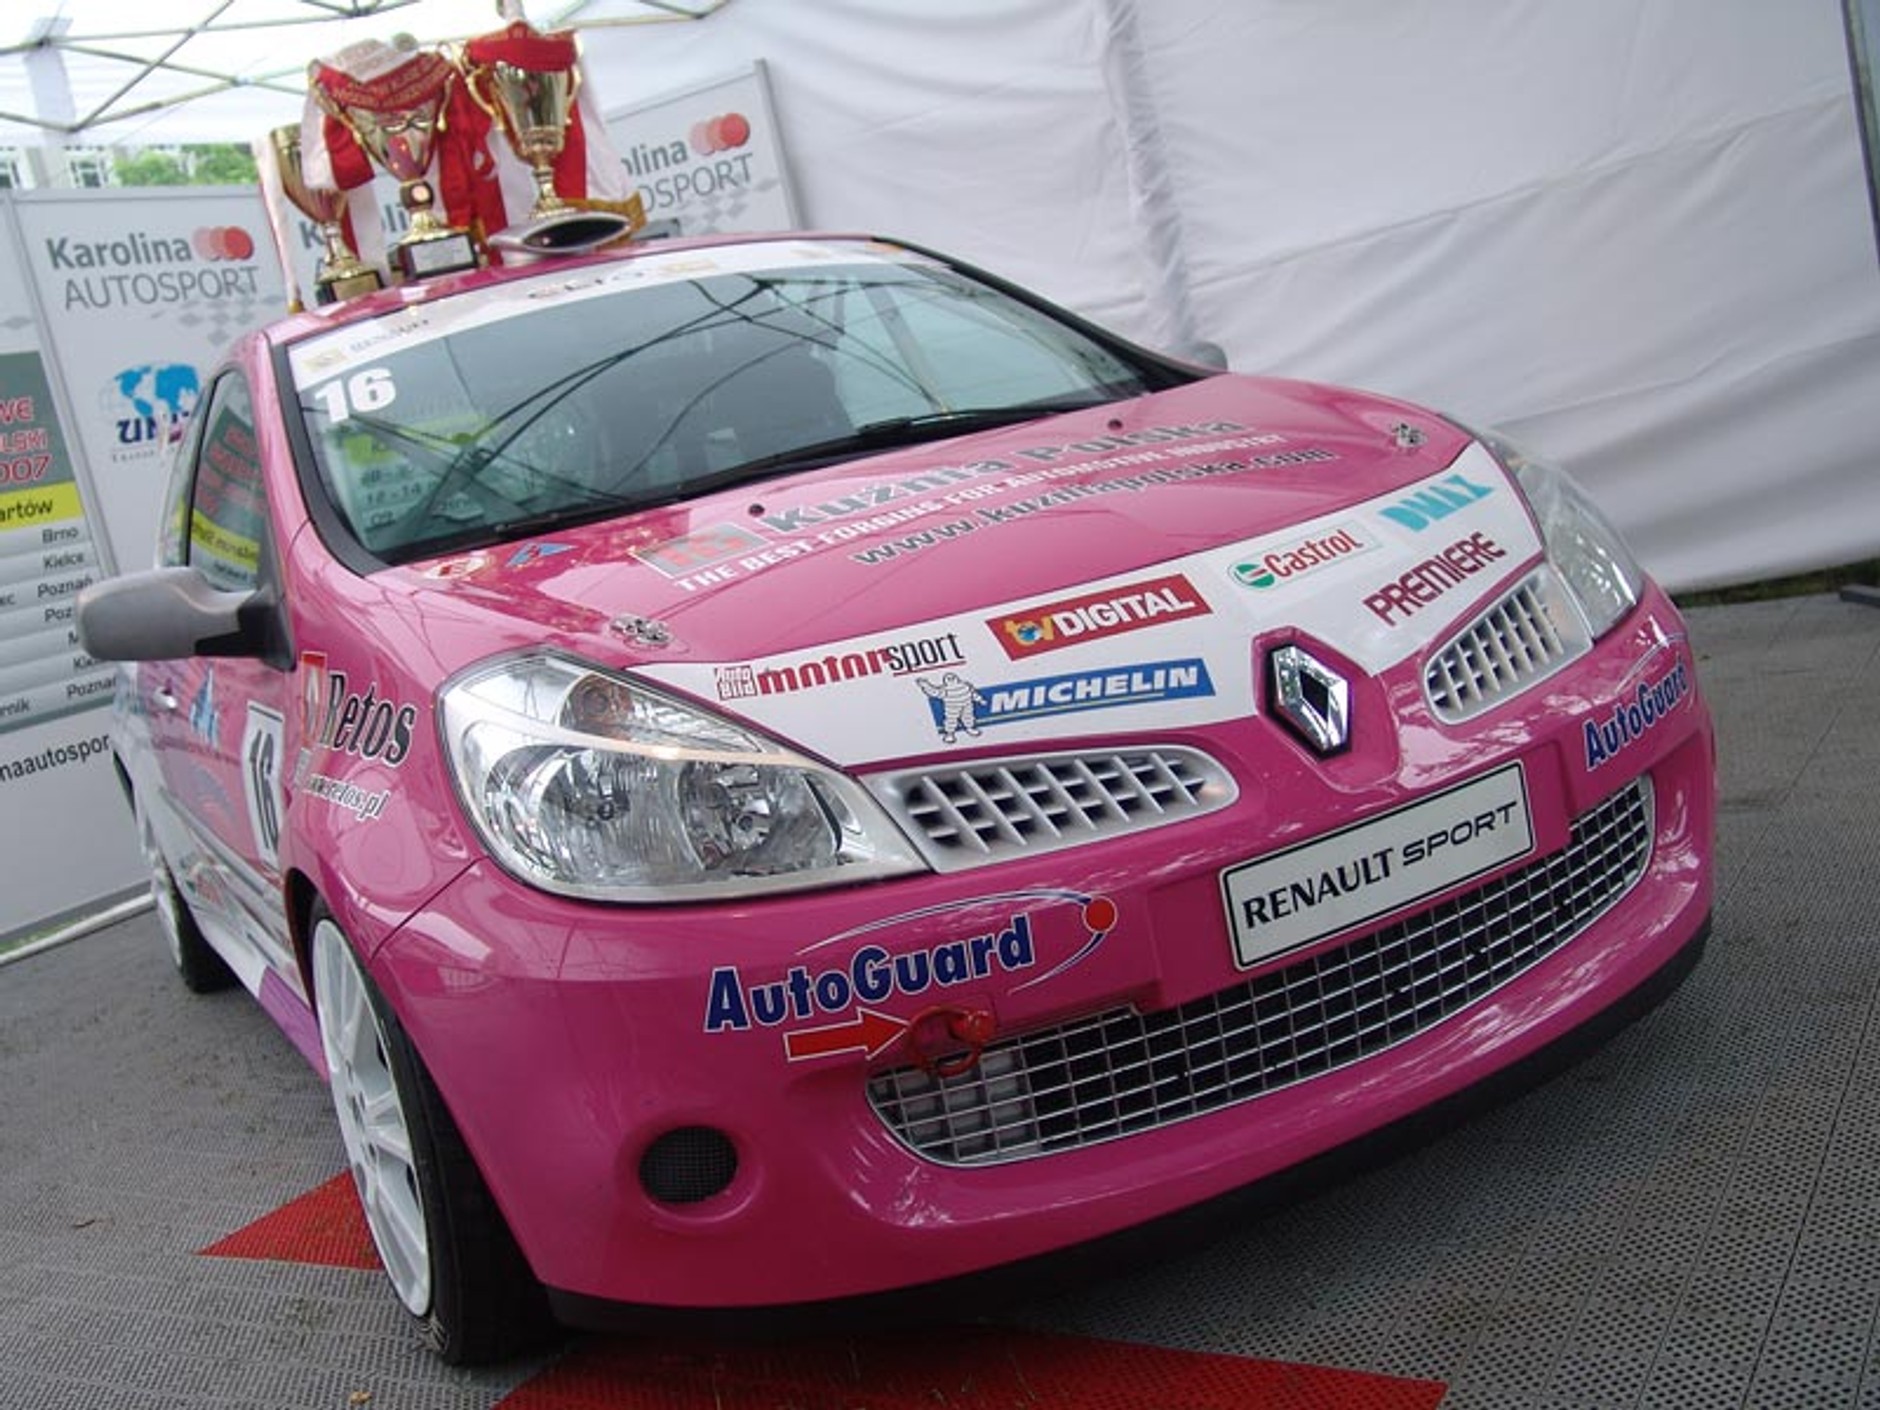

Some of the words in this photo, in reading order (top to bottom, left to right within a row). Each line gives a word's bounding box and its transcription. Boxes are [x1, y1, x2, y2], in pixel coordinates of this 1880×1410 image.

[621, 140, 688, 176] lina
[46, 232, 192, 270] Karolina
[64, 266, 260, 311] AUTOSPORT
[314, 368, 397, 421] 16
[1378, 474, 1496, 532] DMAX
[42, 527, 79, 544] Brno
[674, 563, 737, 592] THE
[739, 540, 817, 572] BEST
[943, 482, 1004, 505] FOR
[1263, 528, 1365, 578] Castrol
[1362, 531, 1507, 627] PREMIERE
[1052, 584, 1196, 637] DIGITAL
[990, 665, 1200, 714] MICHELIN
[319, 670, 415, 766] Retos
[249, 729, 279, 851] 16
[1243, 846, 1393, 930] RENAULT
[1402, 800, 1519, 867] SPORT
[704, 912, 1036, 1033] AutoGuard
